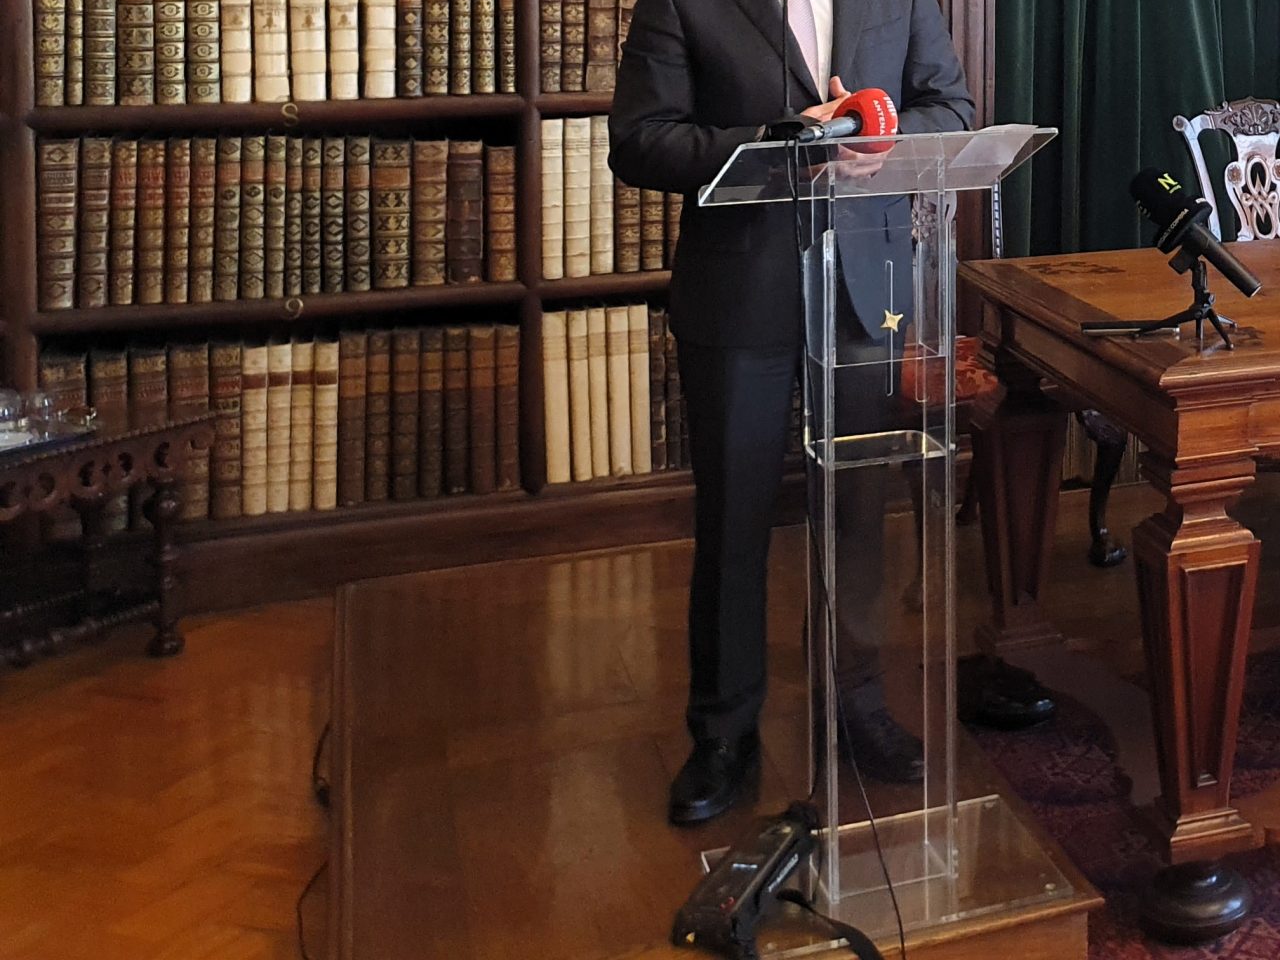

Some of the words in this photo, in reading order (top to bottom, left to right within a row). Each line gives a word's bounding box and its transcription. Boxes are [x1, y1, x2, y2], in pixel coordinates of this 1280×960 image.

[281, 102, 298, 127] 8
[873, 99, 886, 136] ANTENA
[1157, 172, 1179, 191] N
[285, 297, 303, 320] 9
